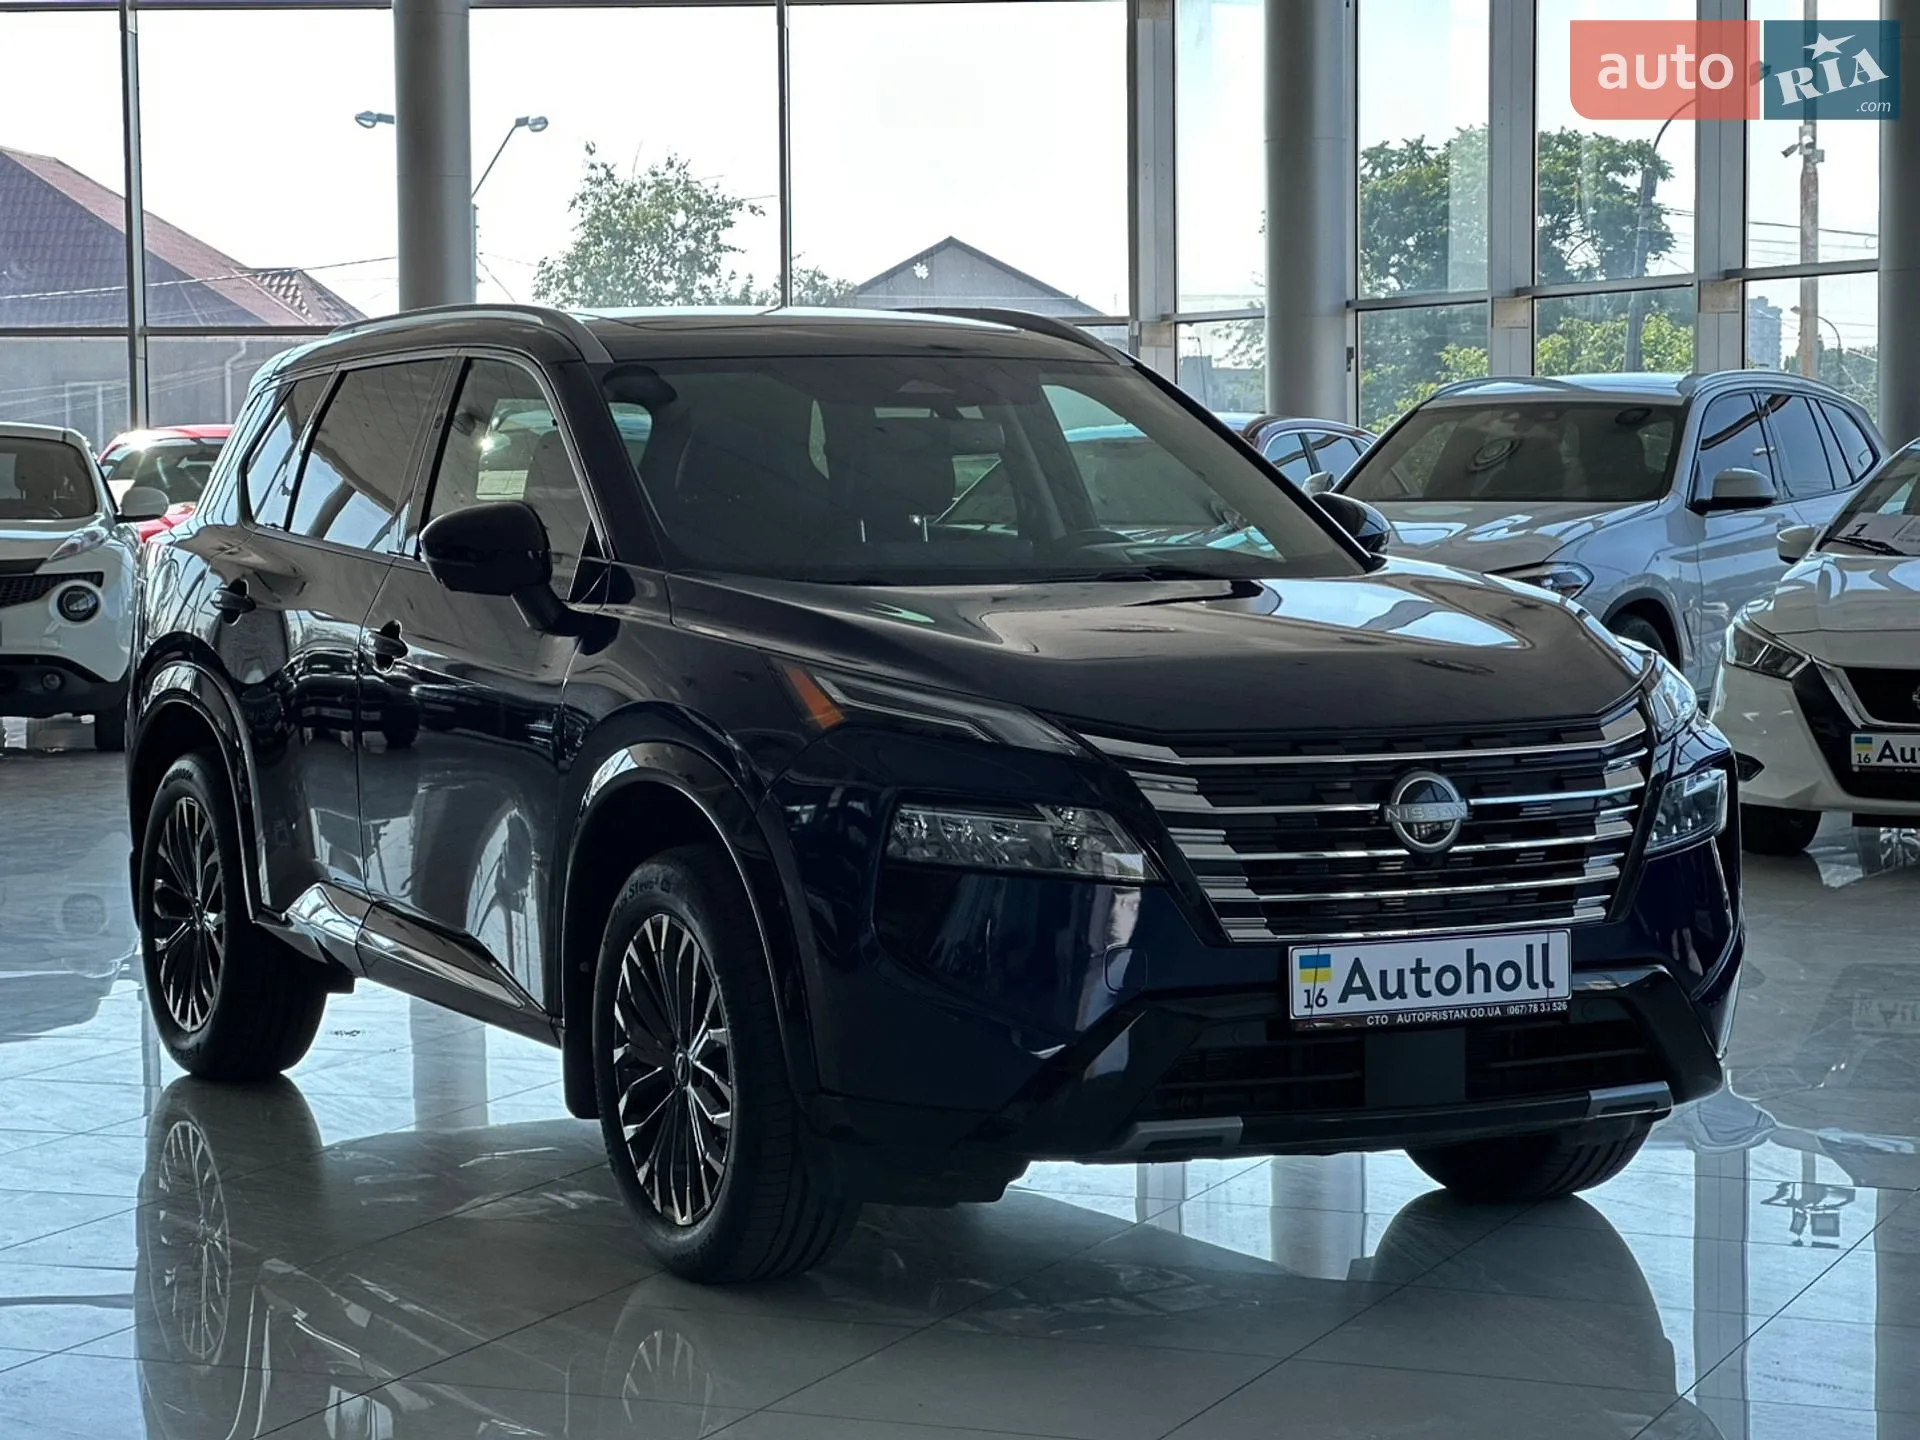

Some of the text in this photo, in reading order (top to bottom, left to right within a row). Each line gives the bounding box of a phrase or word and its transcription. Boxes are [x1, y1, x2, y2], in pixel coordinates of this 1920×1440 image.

[1857, 753, 1871, 764] 16
[1876, 739, 1920, 764] Au
[1386, 804, 1465, 820] NISSAN
[1338, 943, 1555, 1003] Autoholl
[1303, 988, 1328, 1009] 16
[1506, 1004, 1528, 1016] (067)
